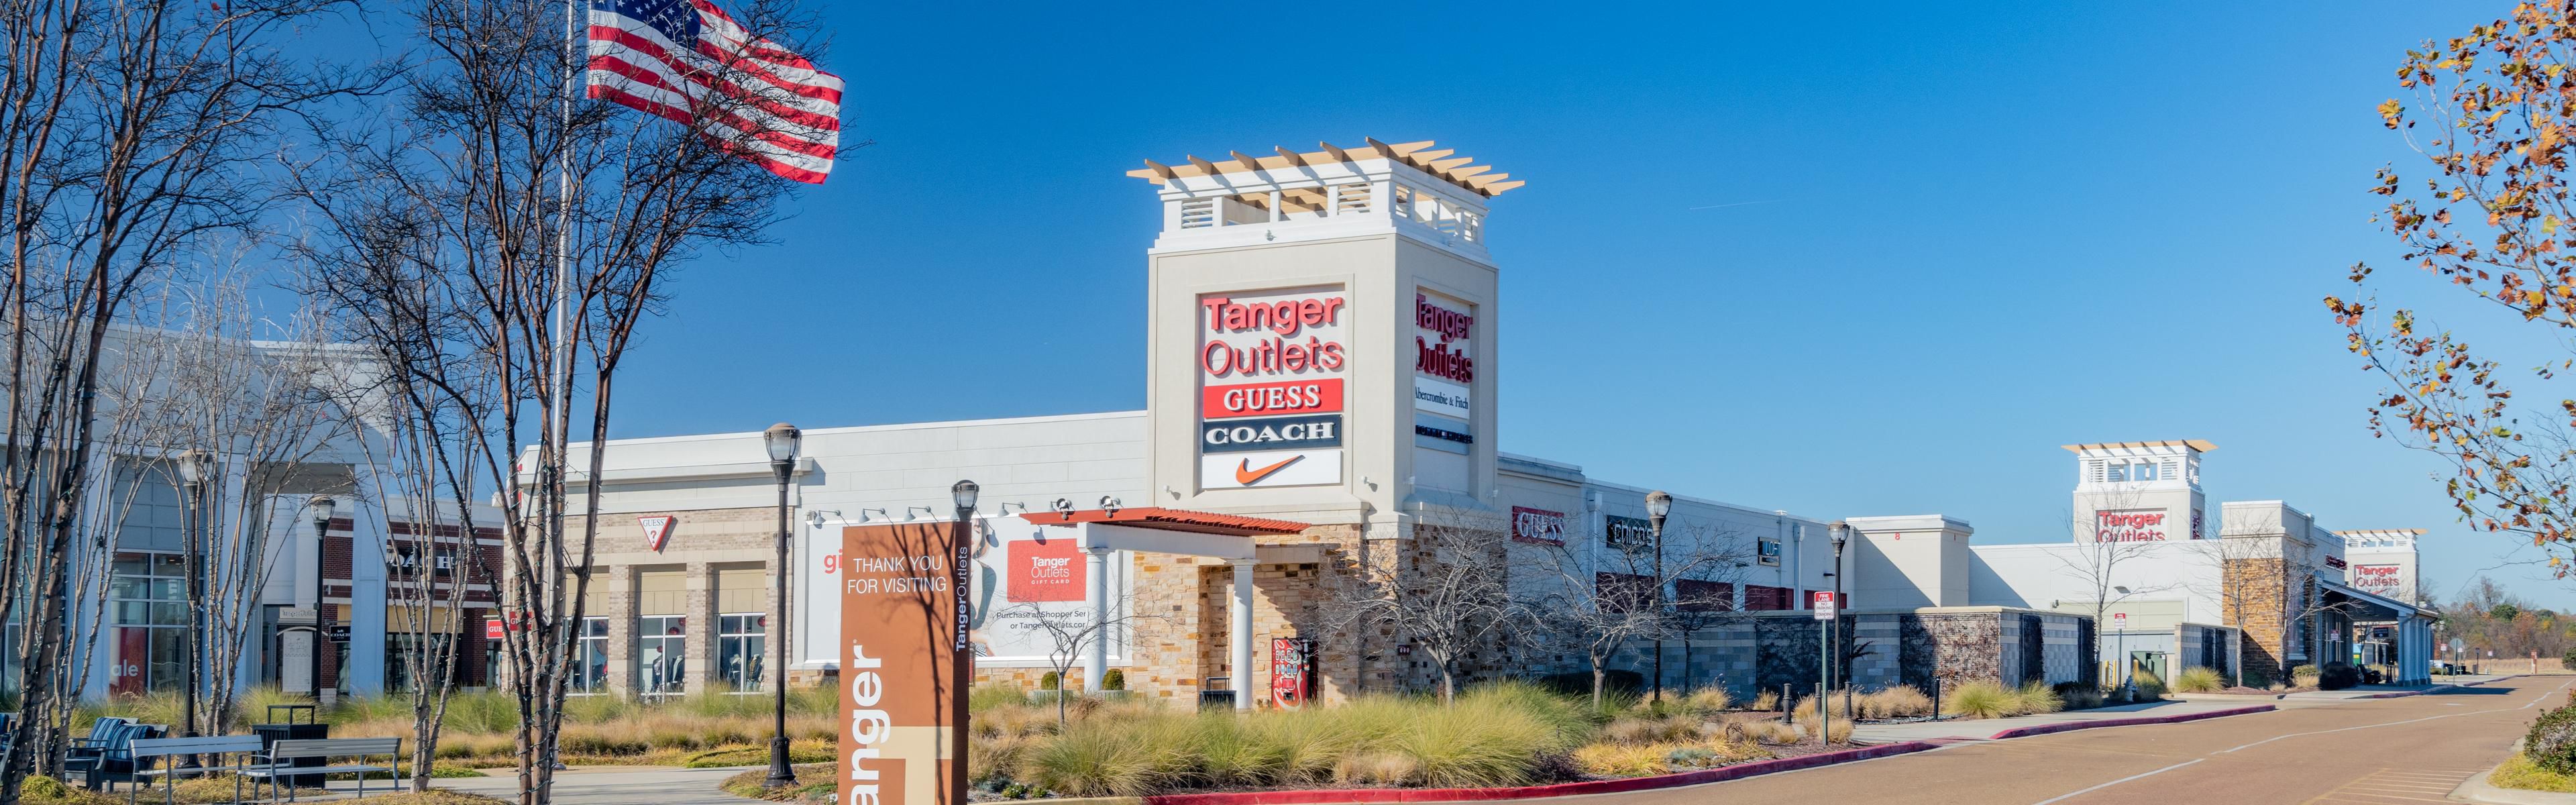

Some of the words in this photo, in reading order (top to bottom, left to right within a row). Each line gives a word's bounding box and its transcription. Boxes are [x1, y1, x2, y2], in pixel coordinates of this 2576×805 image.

[1203, 297, 1343, 335] Tanger
[1416, 293, 1473, 343] Tanger
[1202, 335, 1342, 375] Outlets
[1415, 336, 1473, 383] Outlets
[1224, 384, 1320, 411] GUESS
[1449, 396, 1454, 407] &
[1455, 396, 1469, 409] Fitch
[1206, 422, 1335, 445] COACH
[643, 519, 665, 527] GUESS
[1518, 512, 1564, 541] GUESS
[2098, 511, 2165, 529] Tanger
[1895, 532, 1900, 541] 8
[390, 552, 455, 569] OAH
[853, 557, 906, 573] THANK
[910, 555, 943, 571] YOU
[1031, 556, 1071, 569] Tanger
[1031, 566, 1070, 578] Outlets
[2356, 565, 2399, 576] Tanger
[847, 579, 877, 594] FOR
[883, 576, 947, 593] VISITING
[2356, 577, 2400, 587] Outlets
[957, 547, 968, 652] TangerOutlets
[1041, 611, 1073, 619] Shopper
[111, 659, 139, 677] ale
[851, 645, 891, 805] anger
